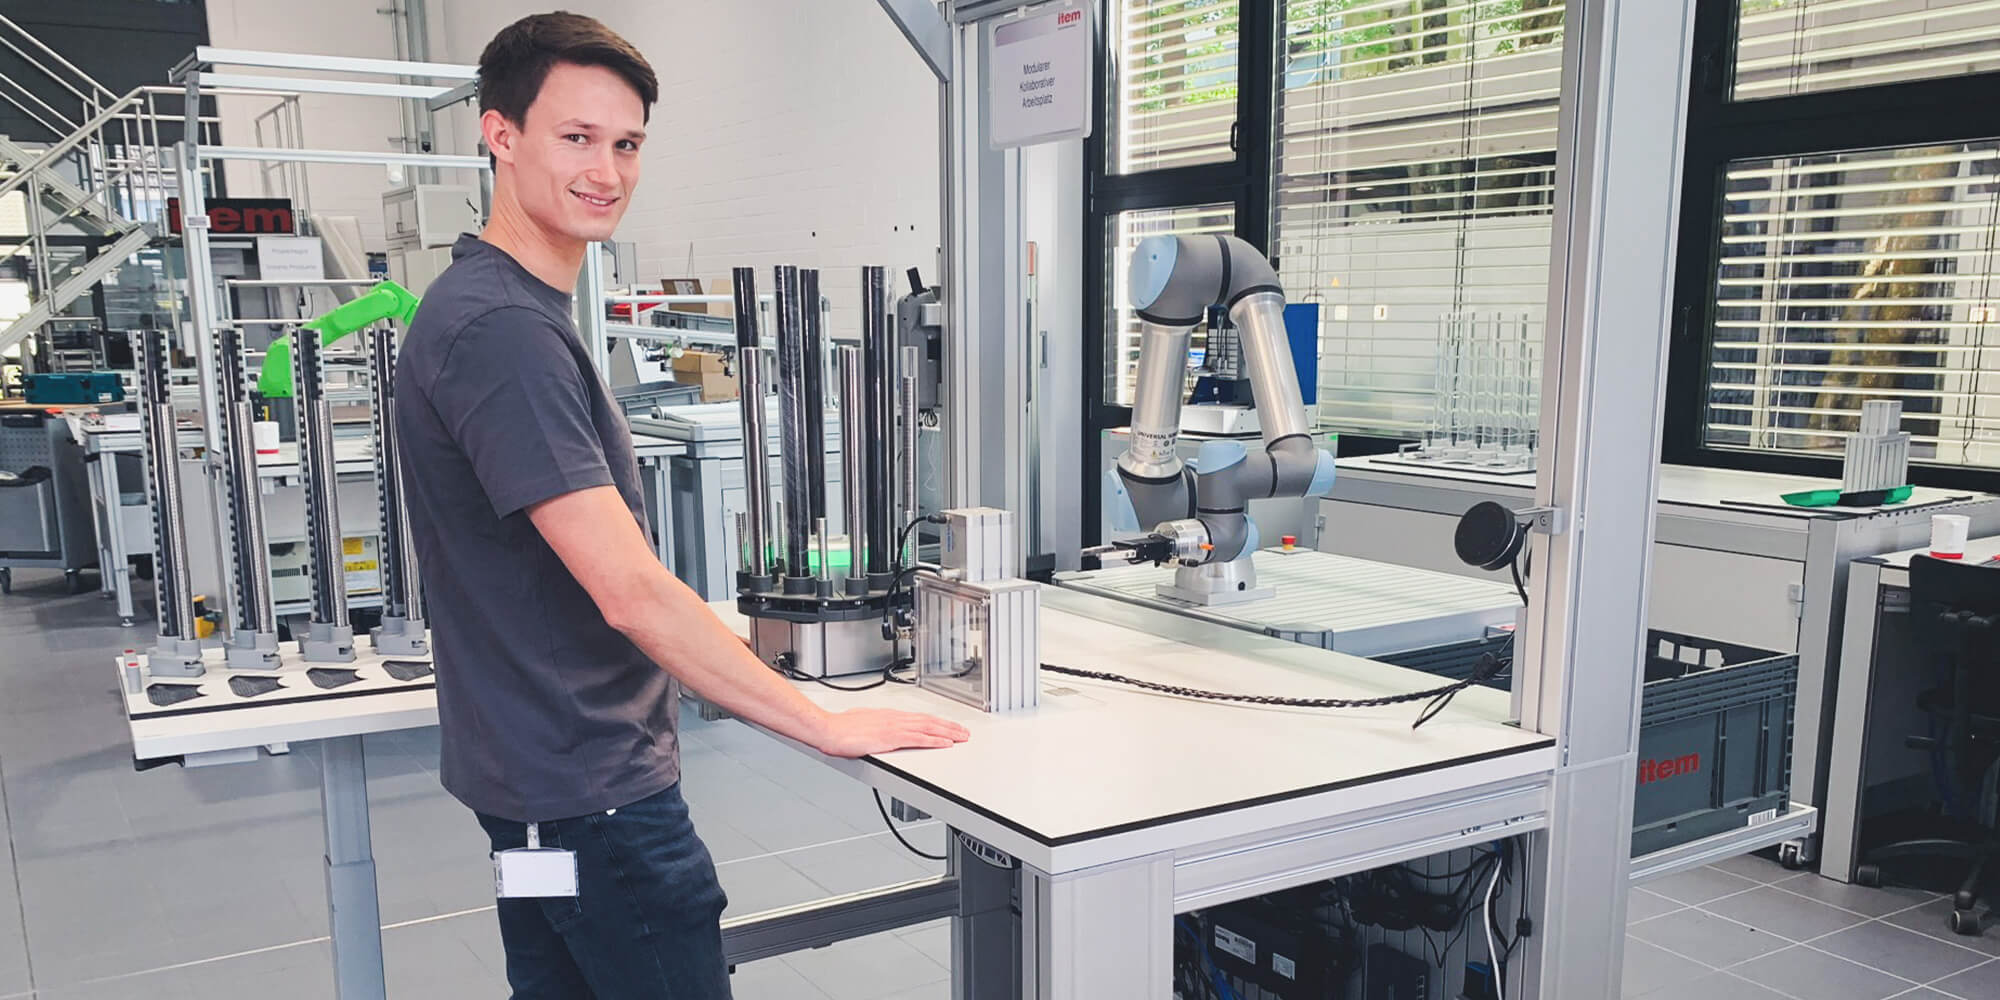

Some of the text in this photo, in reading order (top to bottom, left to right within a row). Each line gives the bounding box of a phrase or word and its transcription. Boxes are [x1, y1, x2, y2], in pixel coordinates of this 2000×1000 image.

[1058, 10, 1081, 24] item
[1023, 61, 1050, 75] Modularer
[168, 197, 292, 233] iem
[1640, 753, 1699, 785] item
